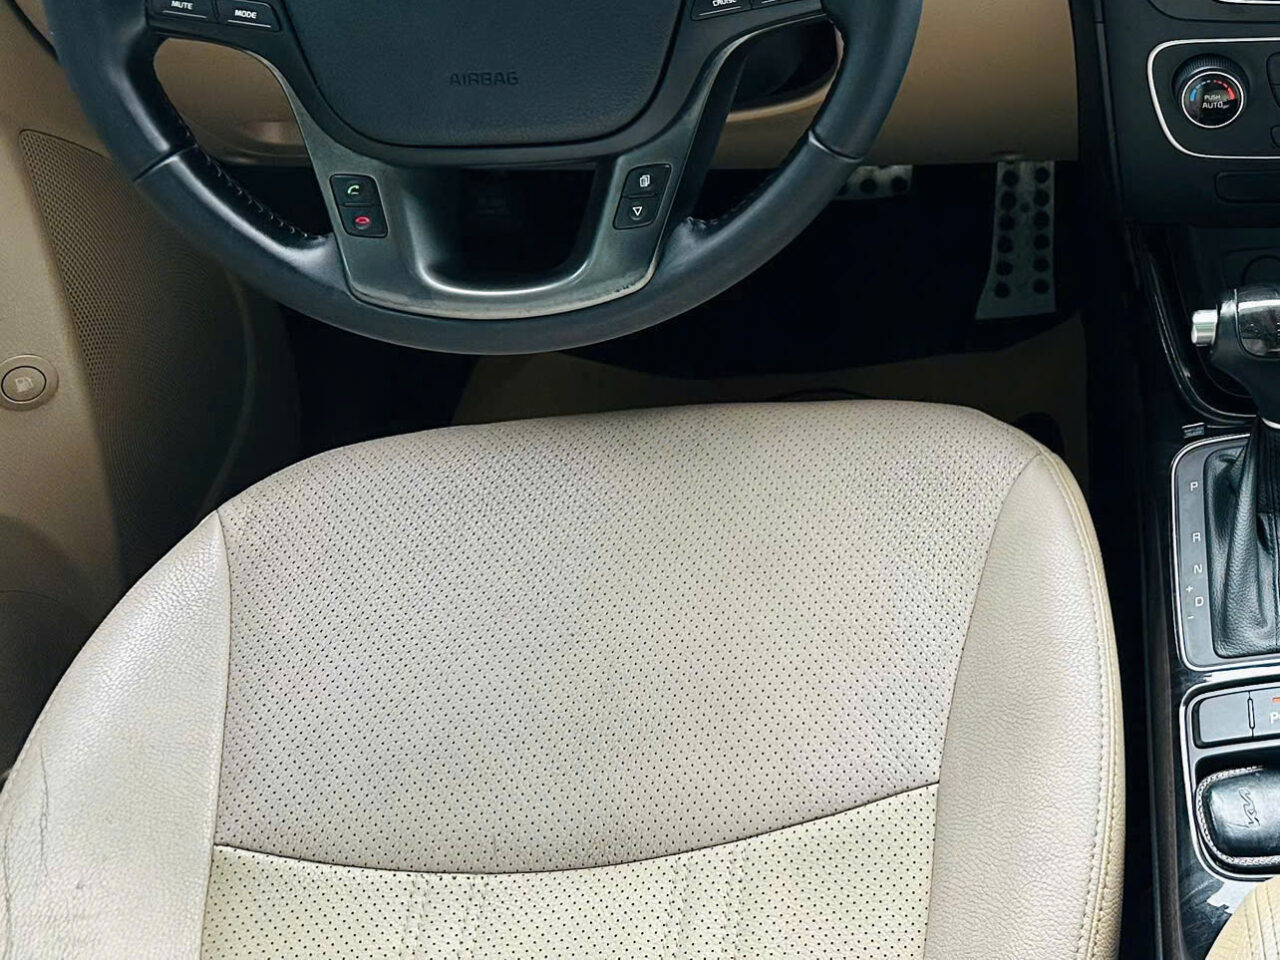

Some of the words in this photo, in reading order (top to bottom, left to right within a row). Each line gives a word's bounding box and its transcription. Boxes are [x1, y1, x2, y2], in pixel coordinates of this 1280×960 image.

[171, 0, 193, 10] MUTE
[234, 9, 257, 19] MODE
[449, 71, 519, 86] AIRBAG
[1202, 101, 1223, 109] AUTO
[1190, 481, 1199, 491] P
[1192, 532, 1201, 542] R
[1194, 564, 1203, 574] N
[1195, 596, 1204, 607] D
